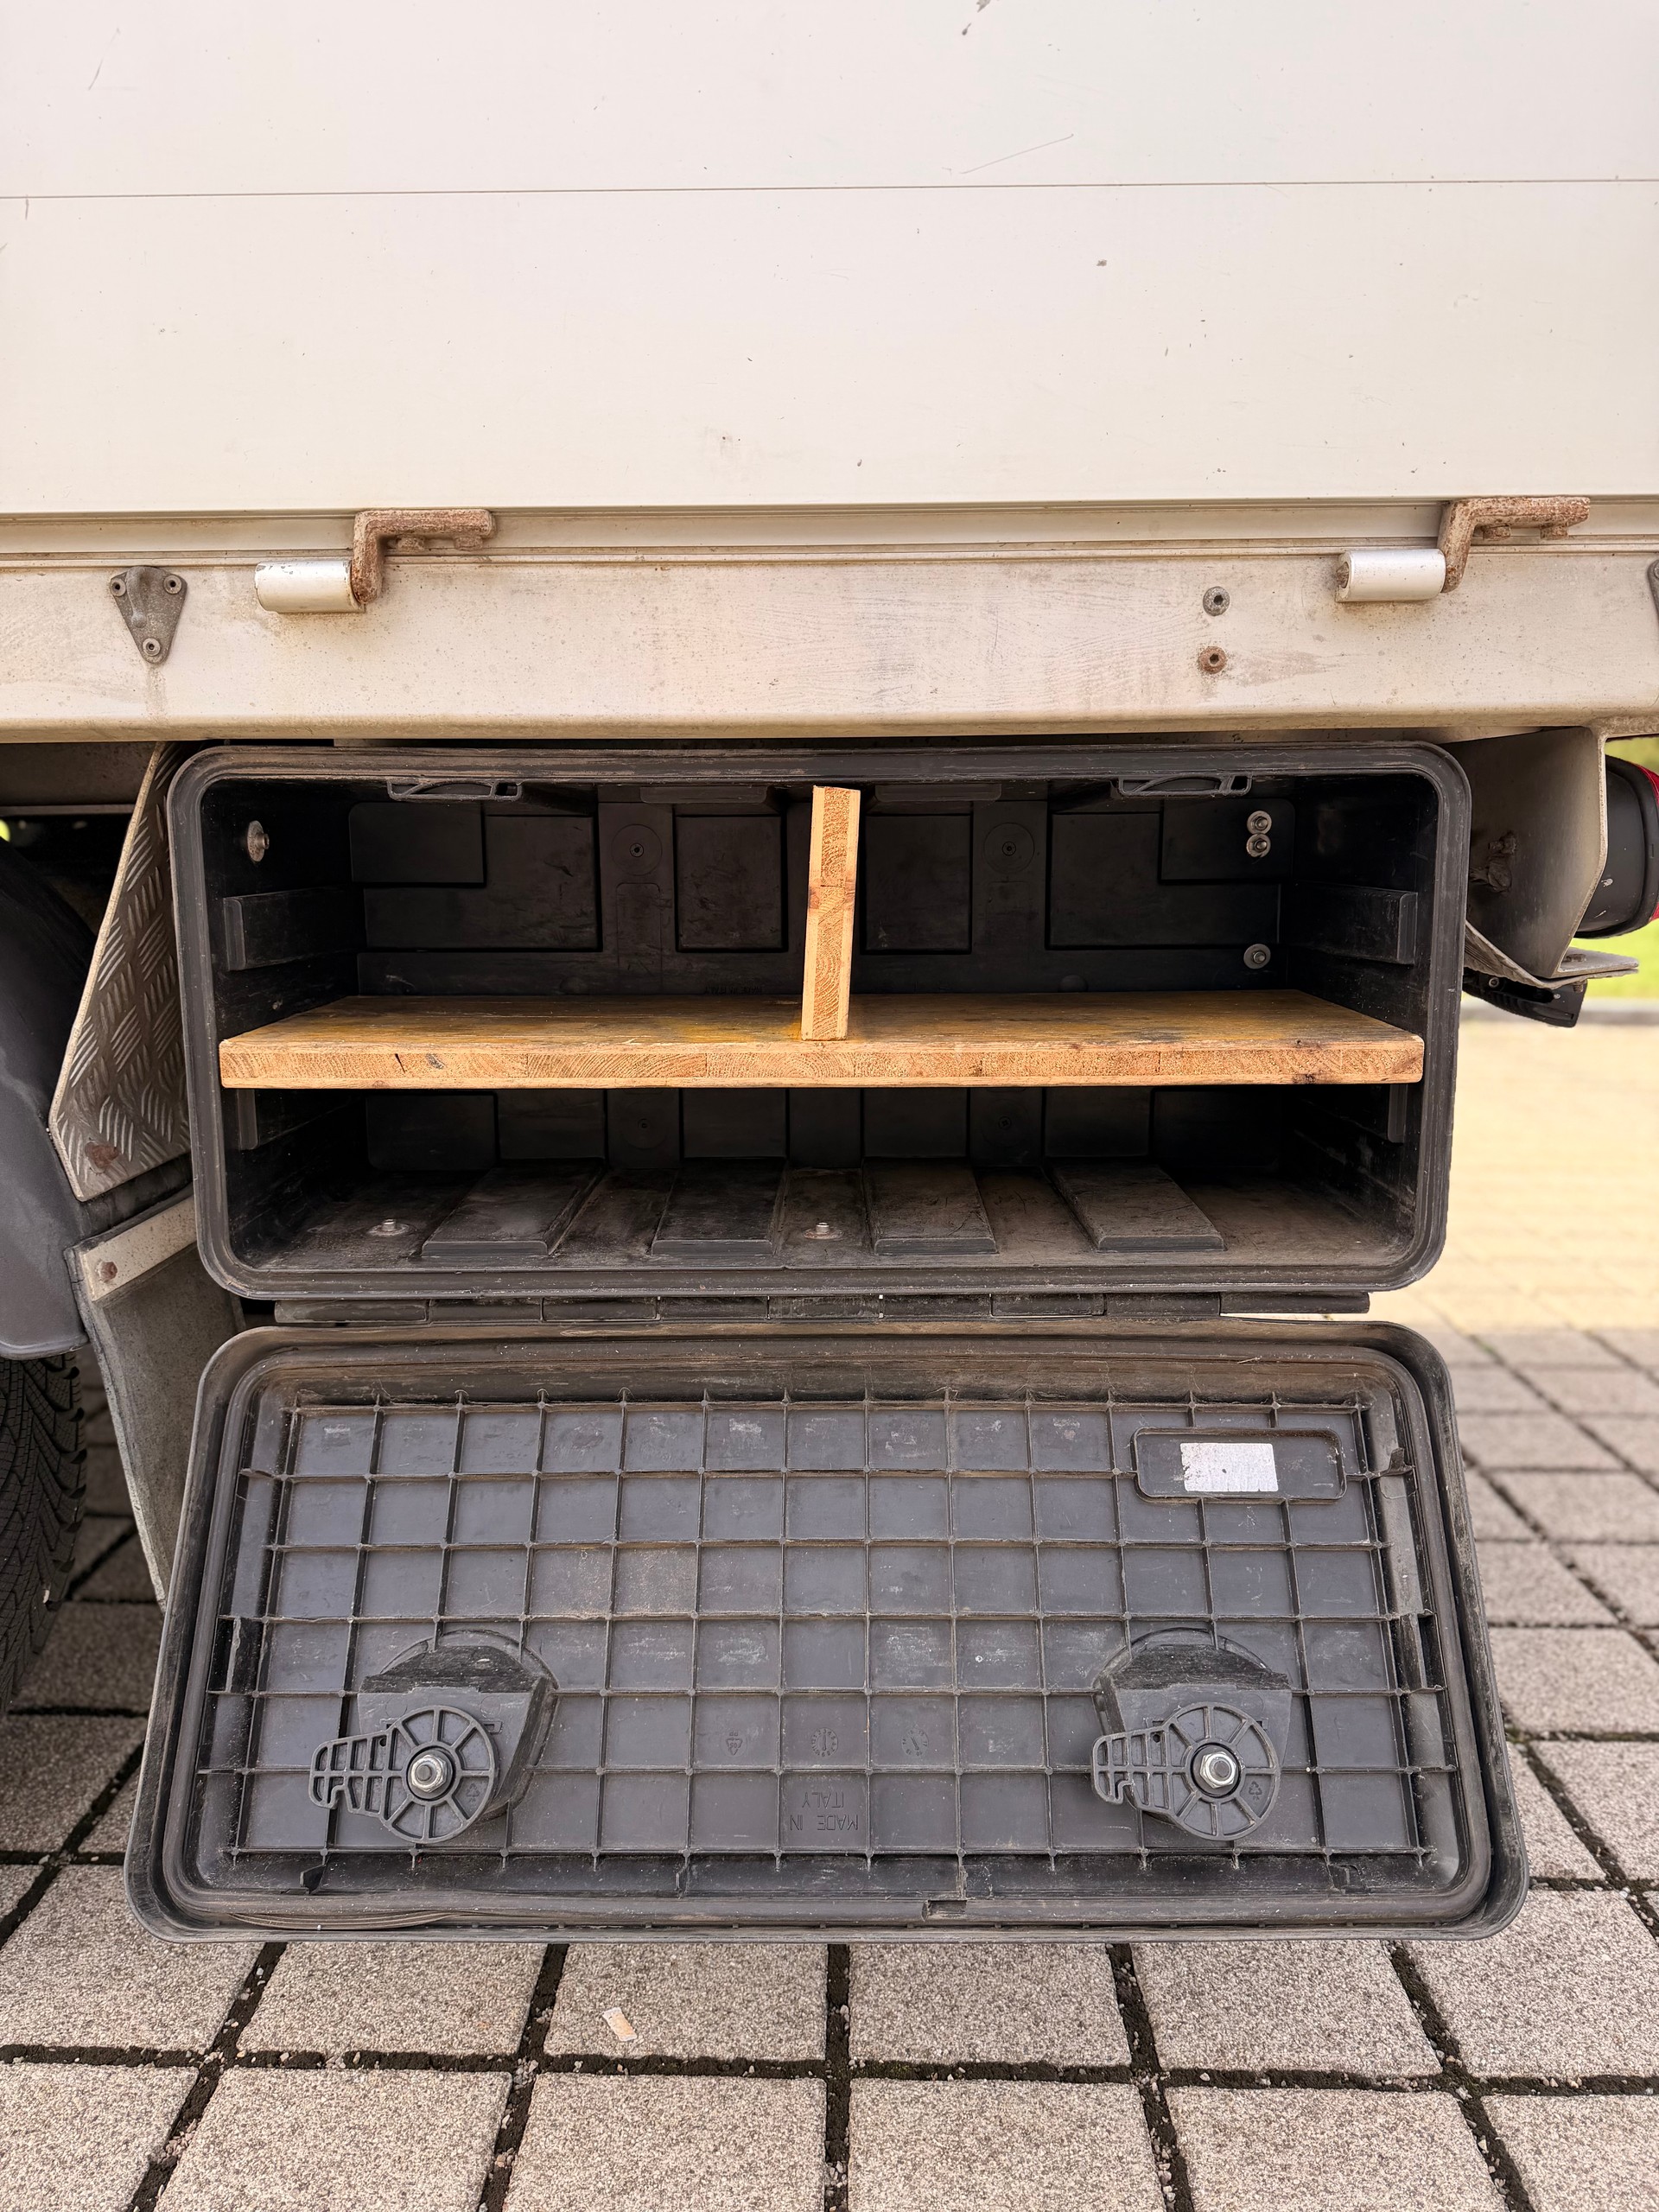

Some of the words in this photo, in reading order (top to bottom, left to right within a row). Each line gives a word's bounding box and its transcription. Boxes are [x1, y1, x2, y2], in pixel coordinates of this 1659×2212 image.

[801, 1791, 844, 1808] ITALY
[790, 1815, 804, 1831] IN
[817, 1815, 858, 1831] MADE
